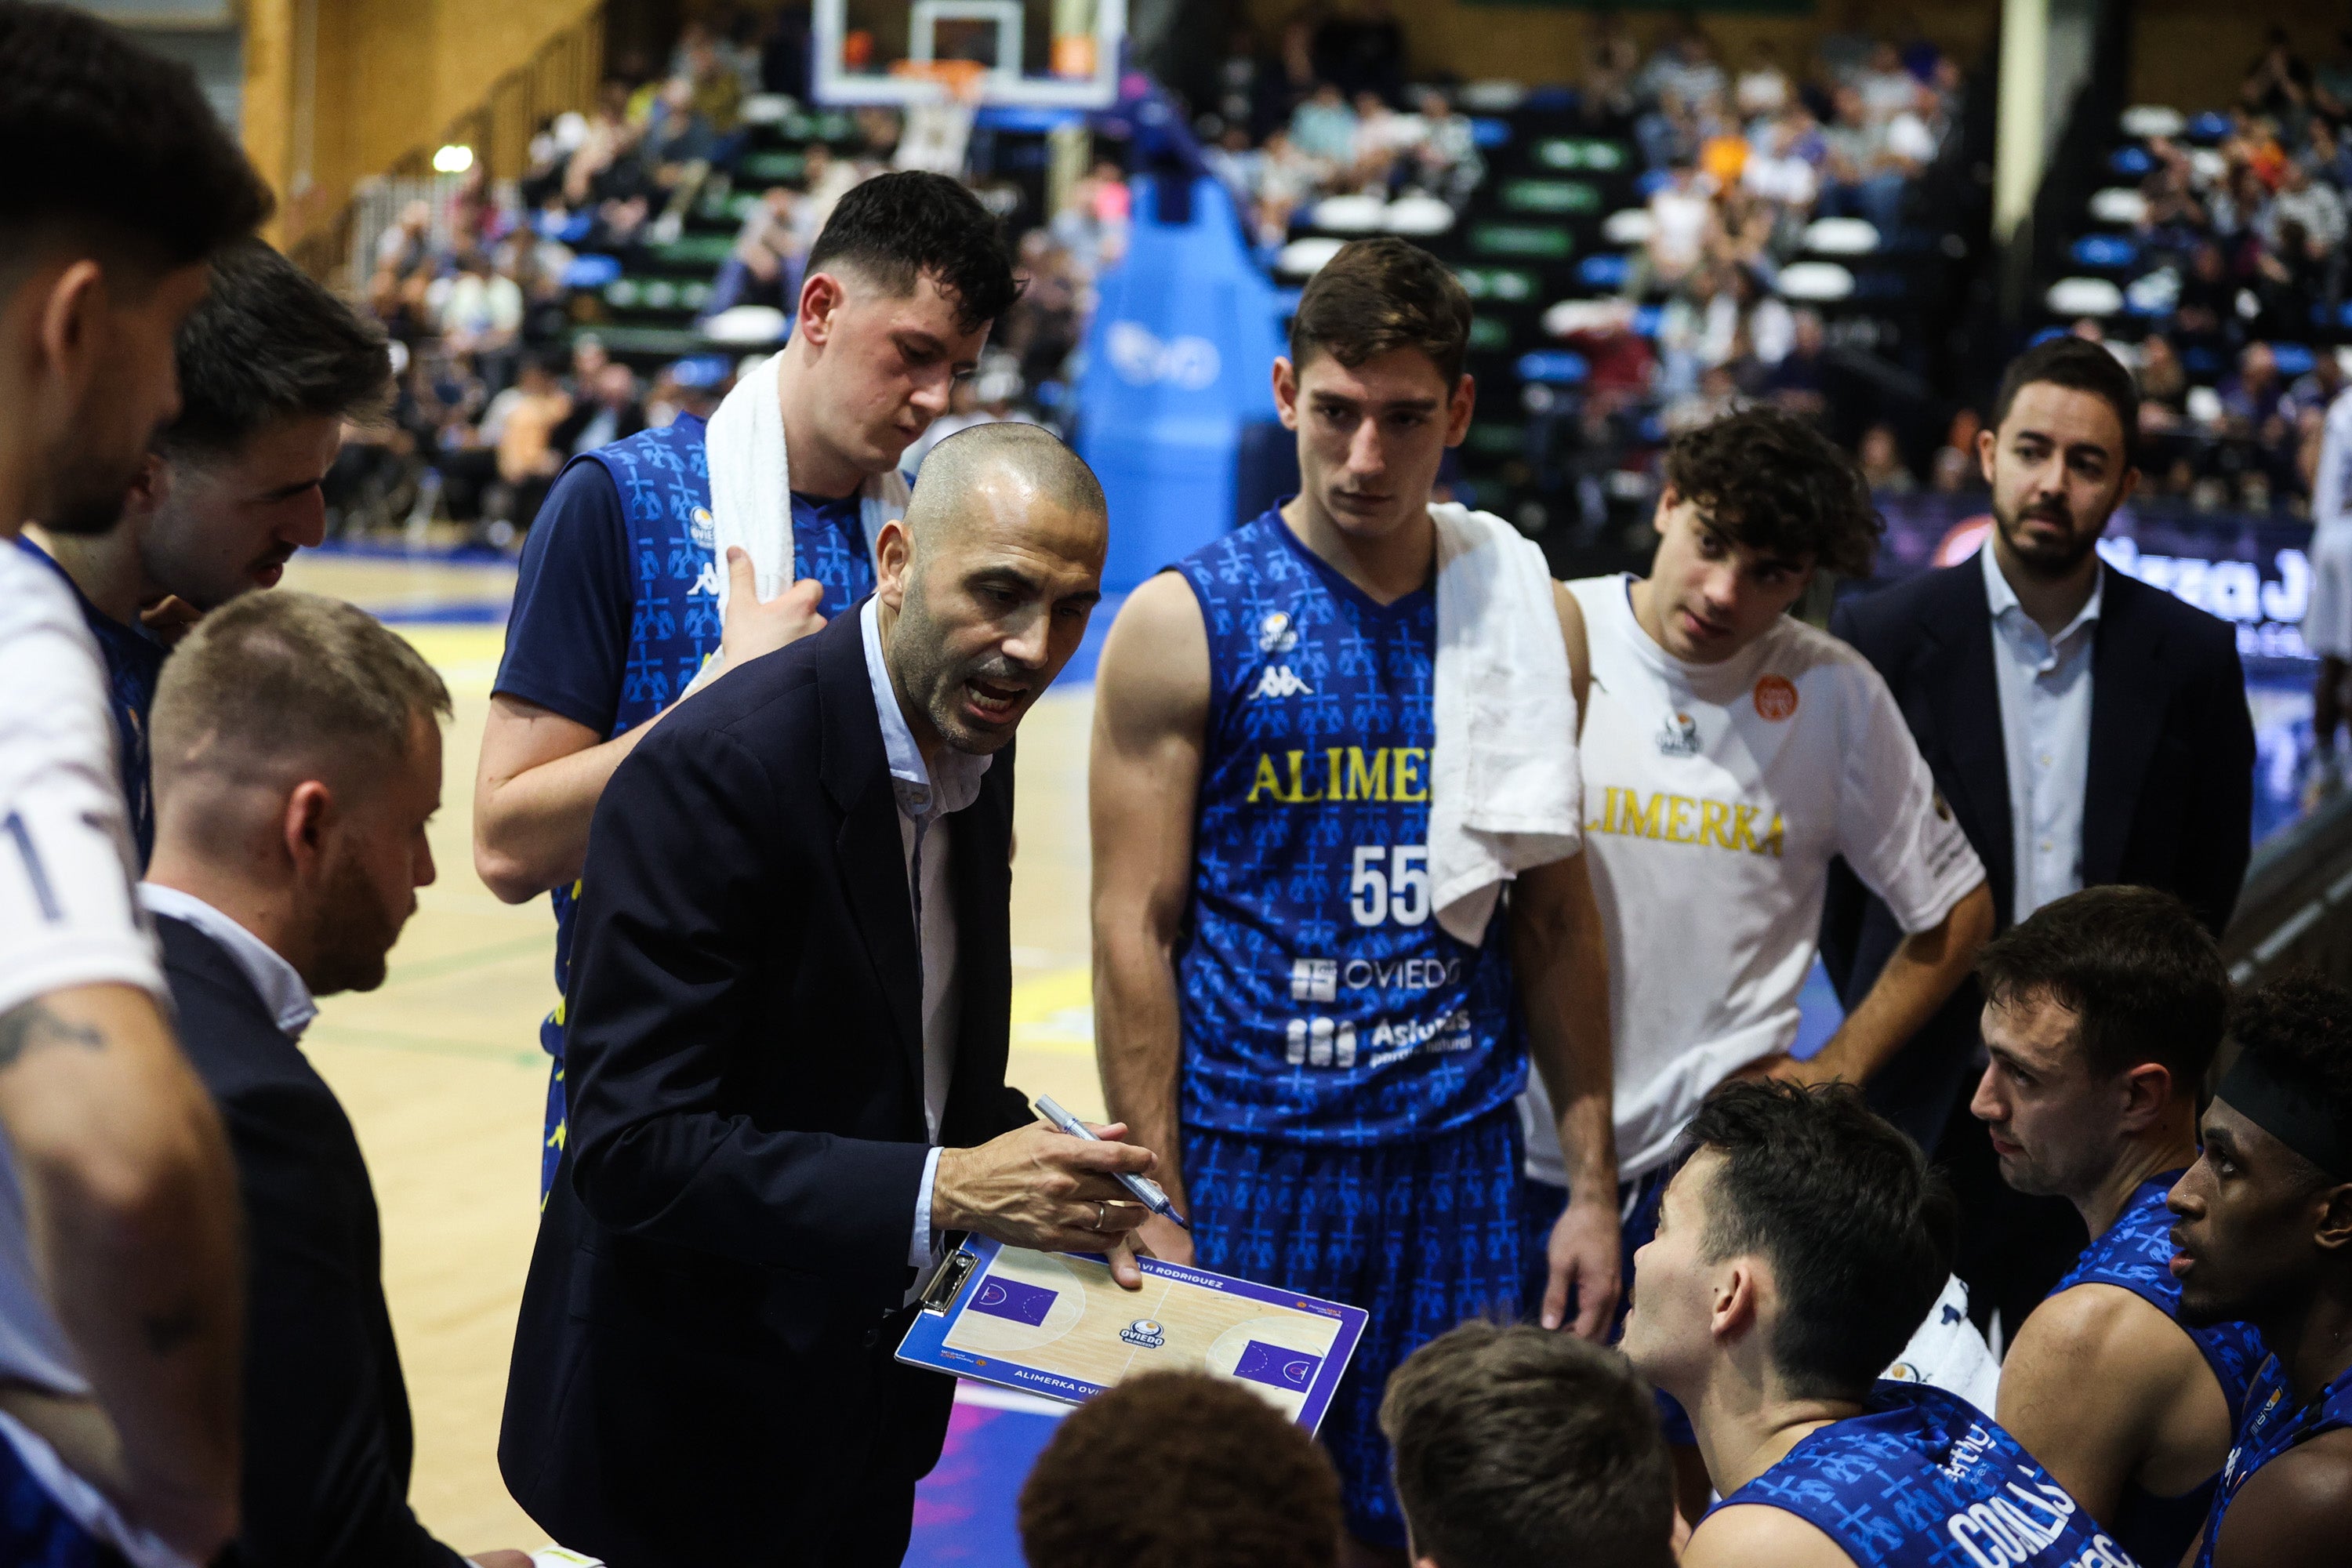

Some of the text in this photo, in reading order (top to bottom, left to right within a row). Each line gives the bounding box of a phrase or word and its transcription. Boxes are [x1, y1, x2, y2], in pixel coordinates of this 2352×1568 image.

[1247, 746, 1434, 803] ALIME
[1350, 844, 1431, 927] 55
[1156, 1265, 1224, 1288] RODRIGUEZ
[1120, 1329, 1163, 1345] OVIEDO
[1014, 1370, 1075, 1390] ALIMERKA
